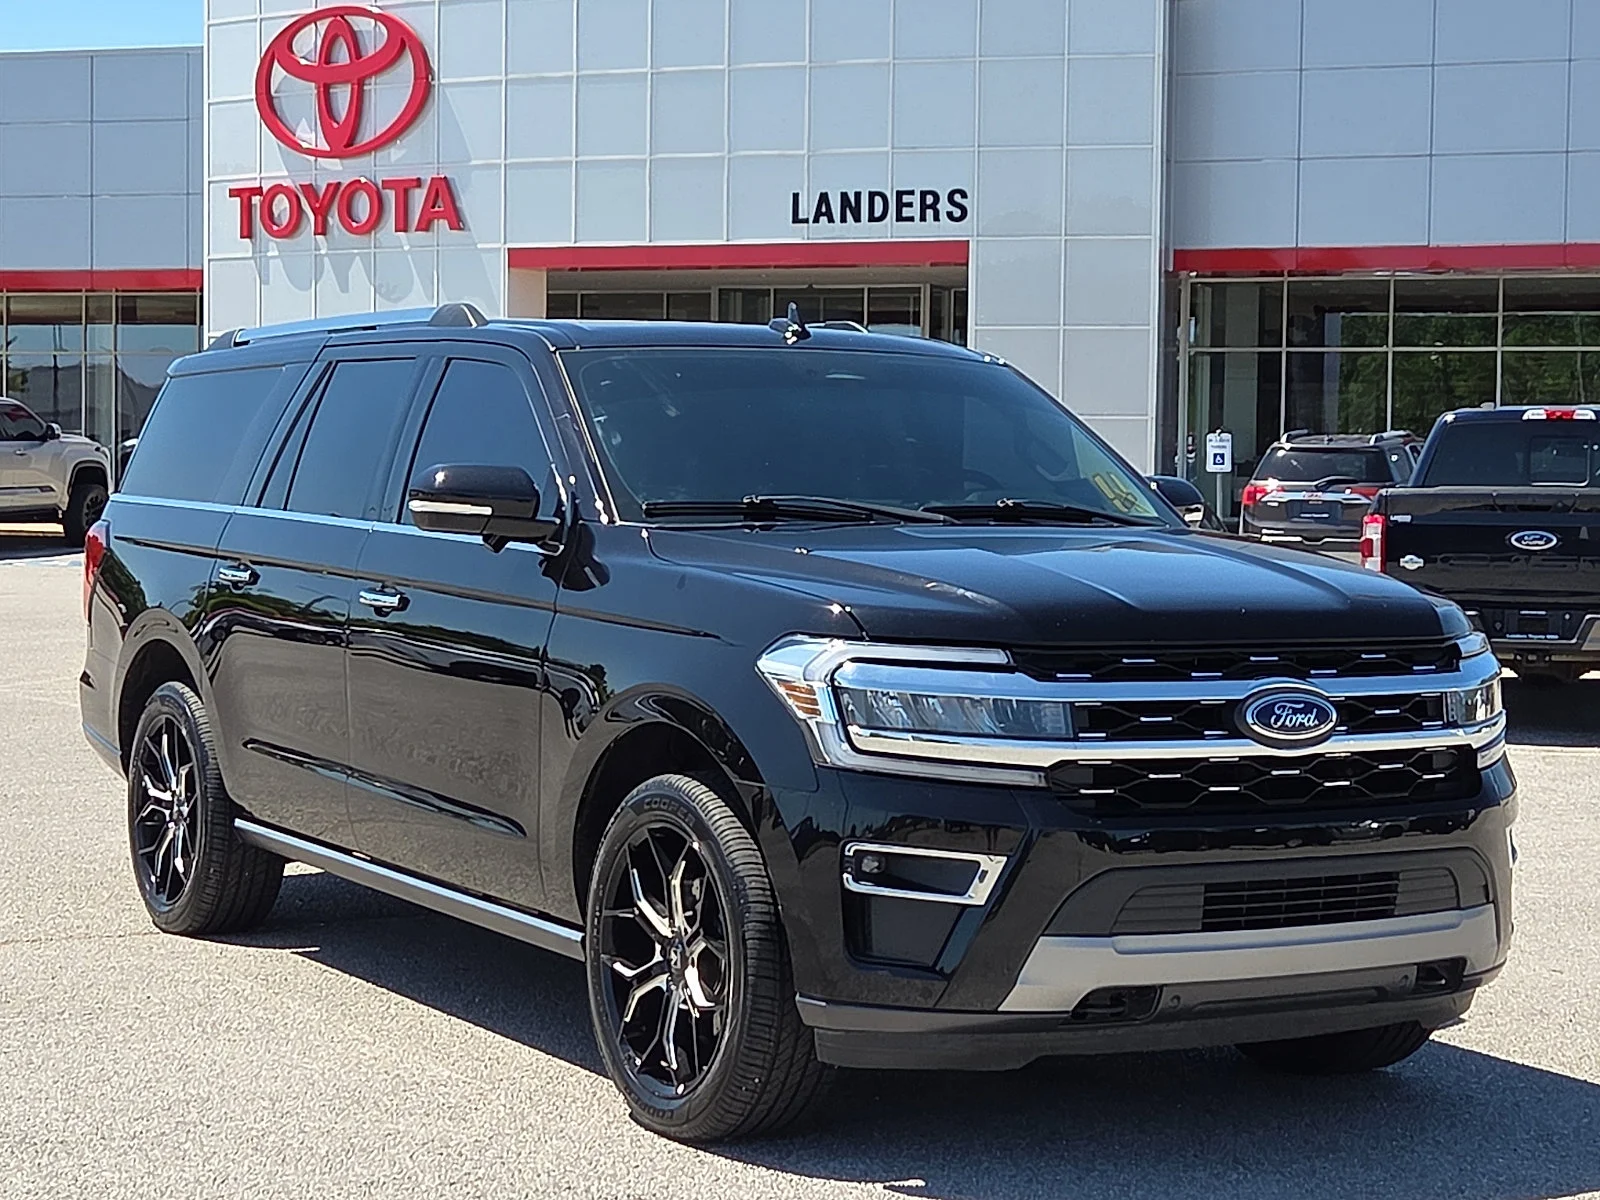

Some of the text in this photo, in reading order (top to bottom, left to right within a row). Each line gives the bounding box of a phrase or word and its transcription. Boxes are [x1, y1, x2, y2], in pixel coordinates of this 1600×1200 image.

[229, 175, 465, 239] TOYOTA
[791, 188, 969, 224] LANDERS
[1270, 702, 1320, 728] Ford
